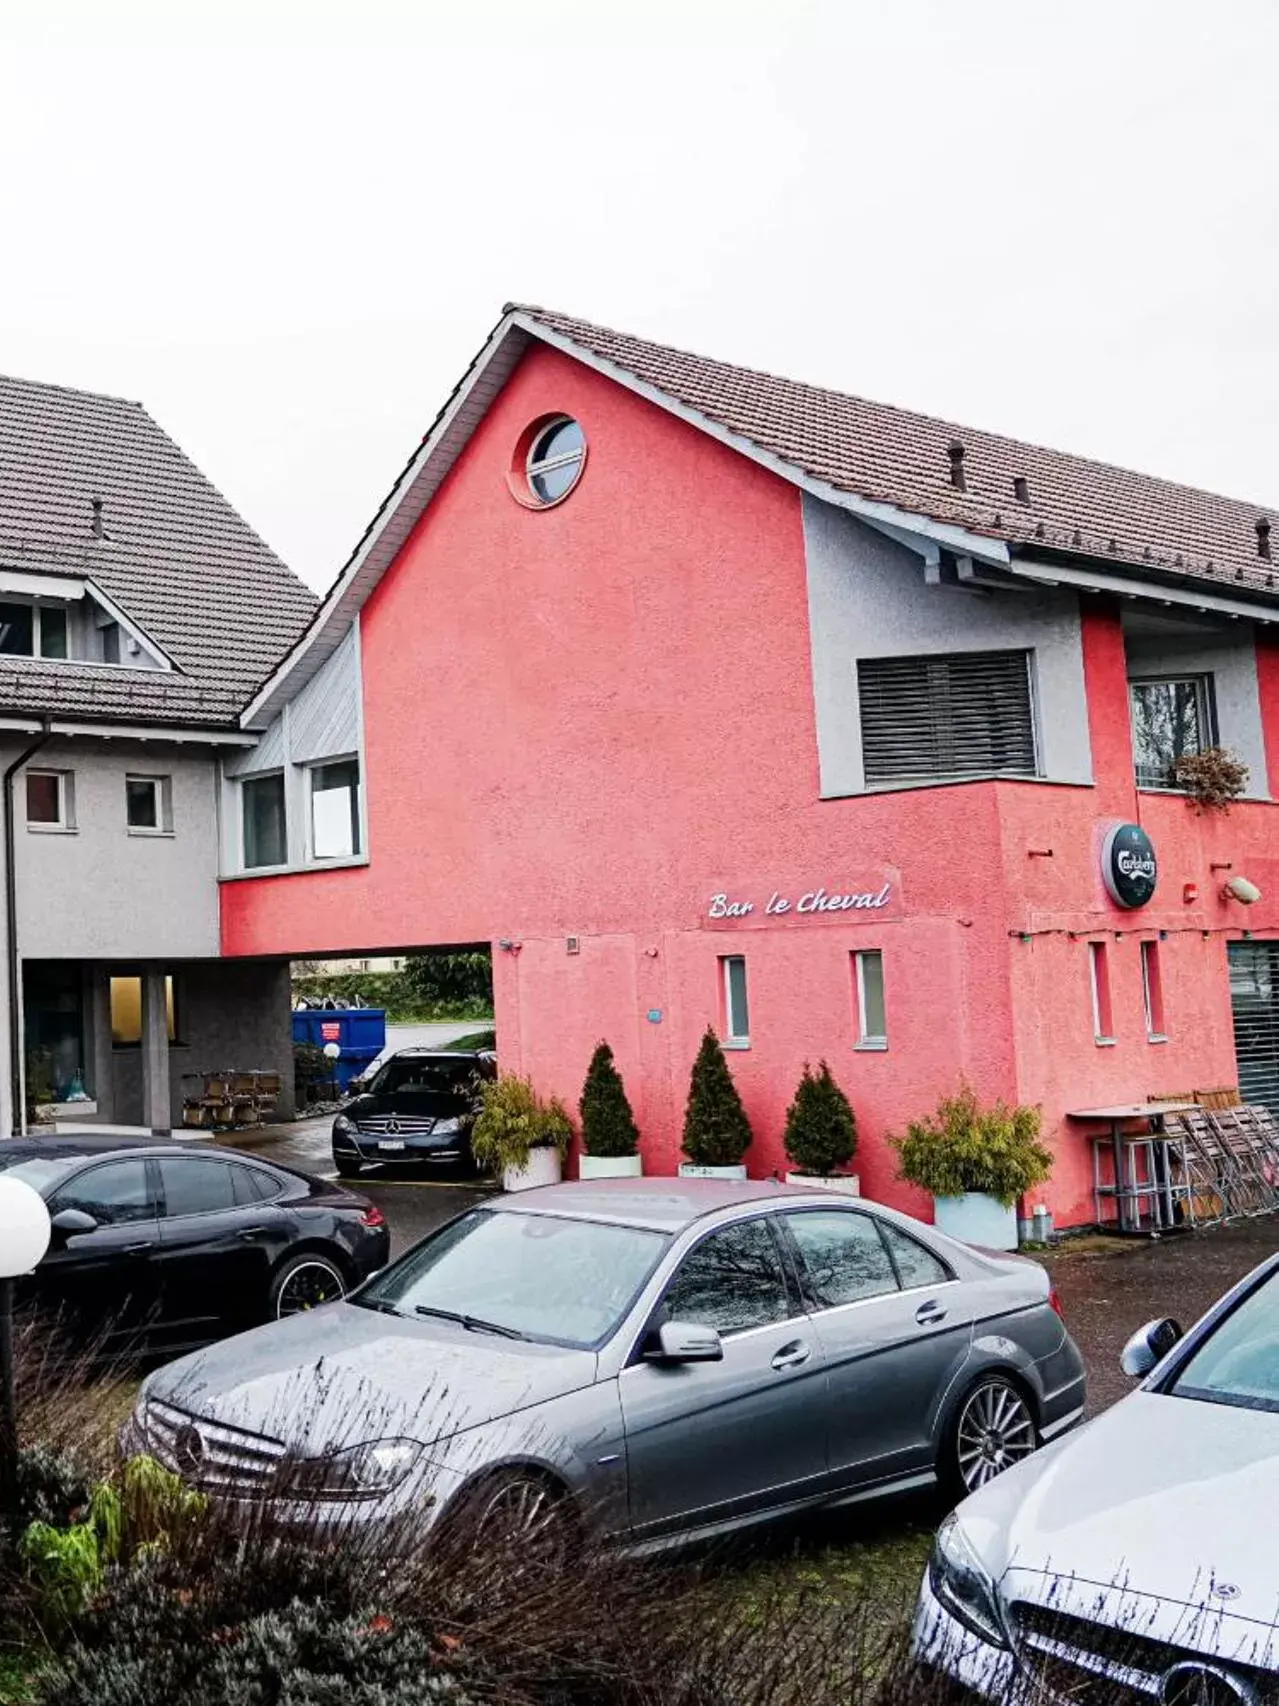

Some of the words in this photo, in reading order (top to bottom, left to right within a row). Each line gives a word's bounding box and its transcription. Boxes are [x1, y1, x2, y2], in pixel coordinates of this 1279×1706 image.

[1118, 850, 1155, 880] Carlsberg
[708, 893, 753, 918] Bar
[765, 891, 791, 914] le
[796, 883, 890, 913] Cheval
